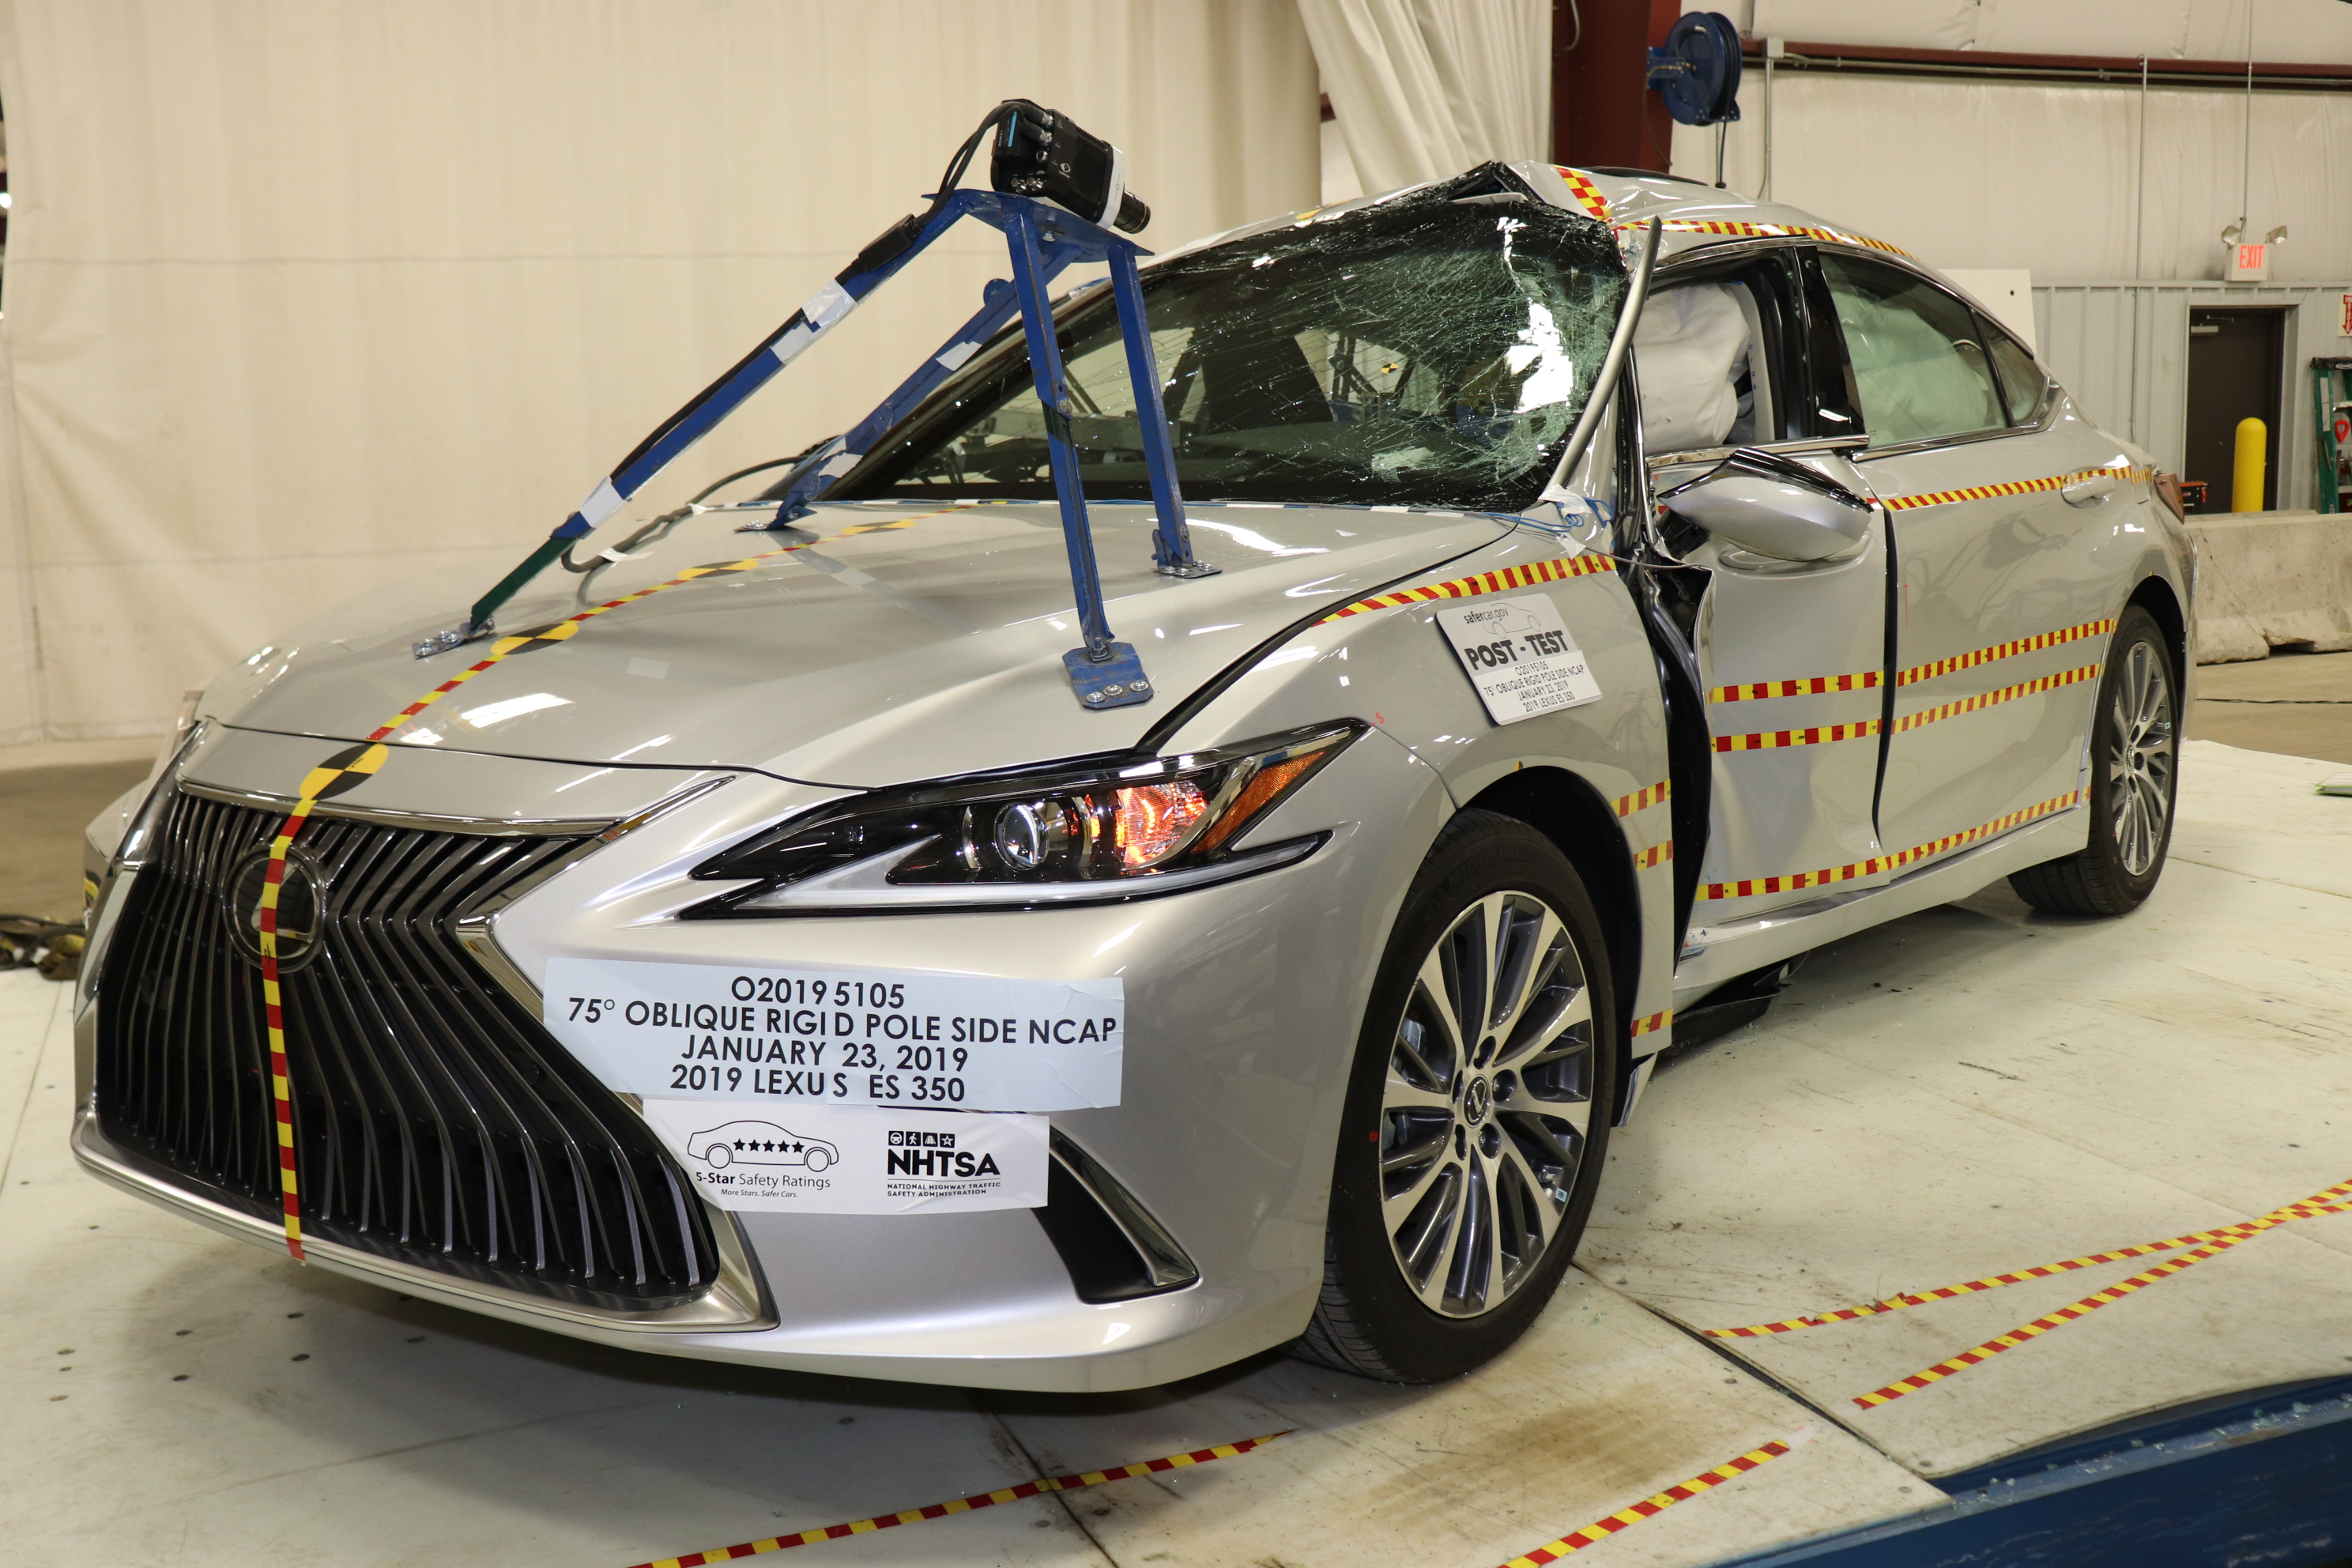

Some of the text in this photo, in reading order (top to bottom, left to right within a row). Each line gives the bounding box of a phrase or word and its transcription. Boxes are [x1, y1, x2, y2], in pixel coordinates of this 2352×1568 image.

[2239, 244, 2266, 270] EXIT
[1464, 608, 1509, 624] safercar.gov
[1464, 639, 1518, 670] POST
[1524, 630, 1569, 657] TEST
[1495, 678, 1525, 694] OBLIQUE
[1523, 674, 1542, 687] RIGID
[1540, 670, 1557, 682] POLE
[1555, 668, 1570, 679] SIDE
[1566, 664, 1585, 676] NCAP
[1517, 685, 1547, 701] JANUARY
[1554, 680, 1570, 691] 2019
[1523, 691, 1576, 712] 2019 LEXUS ES 350
[625, 1000, 755, 1031] OBLIQUE
[767, 1008, 854, 1037] RIGID
[866, 1014, 940, 1041] POLE
[952, 1016, 1017, 1043] SIDE
[1029, 1017, 1117, 1044] NCAP
[681, 1035, 968, 1072] JANUARY 23, 2019
[670, 1064, 964, 1102] 2019 LEXUS ES 350
[888, 1148, 1001, 1178] NHTSA
[695, 1171, 831, 1190] 5-Star Safety Ratings
[918, 1189, 986, 1197] ADMINISTRATION
